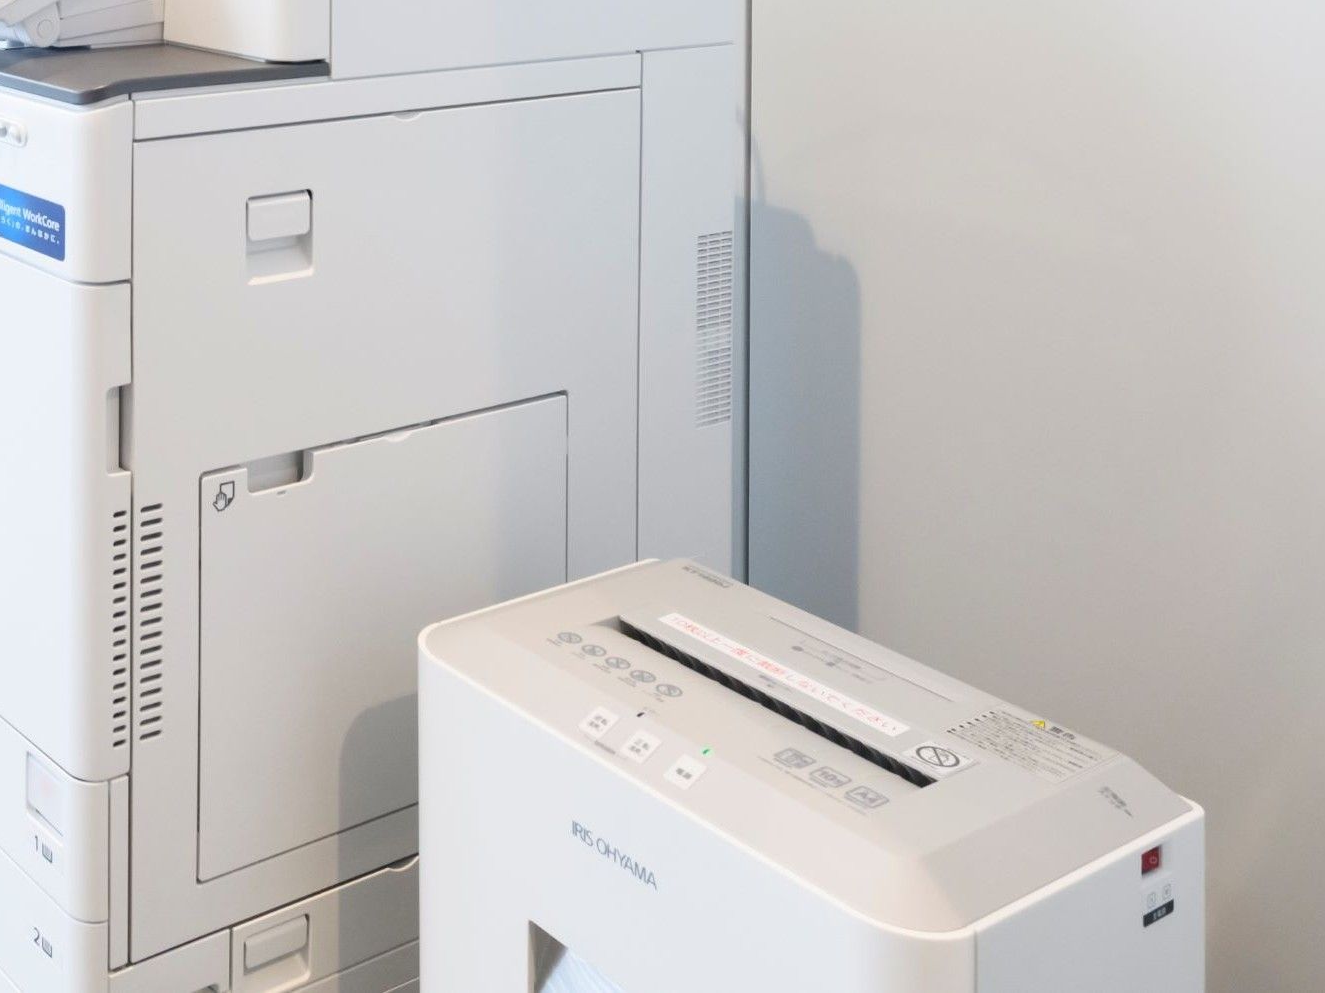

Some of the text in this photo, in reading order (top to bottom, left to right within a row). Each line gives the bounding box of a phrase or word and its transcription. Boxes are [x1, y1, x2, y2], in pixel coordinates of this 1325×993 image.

[22, 208, 60, 232] WorkCore
[34, 835, 39, 852] 1
[572, 820, 657, 891] IRIS OHYAMA
[33, 927, 40, 945] 2
